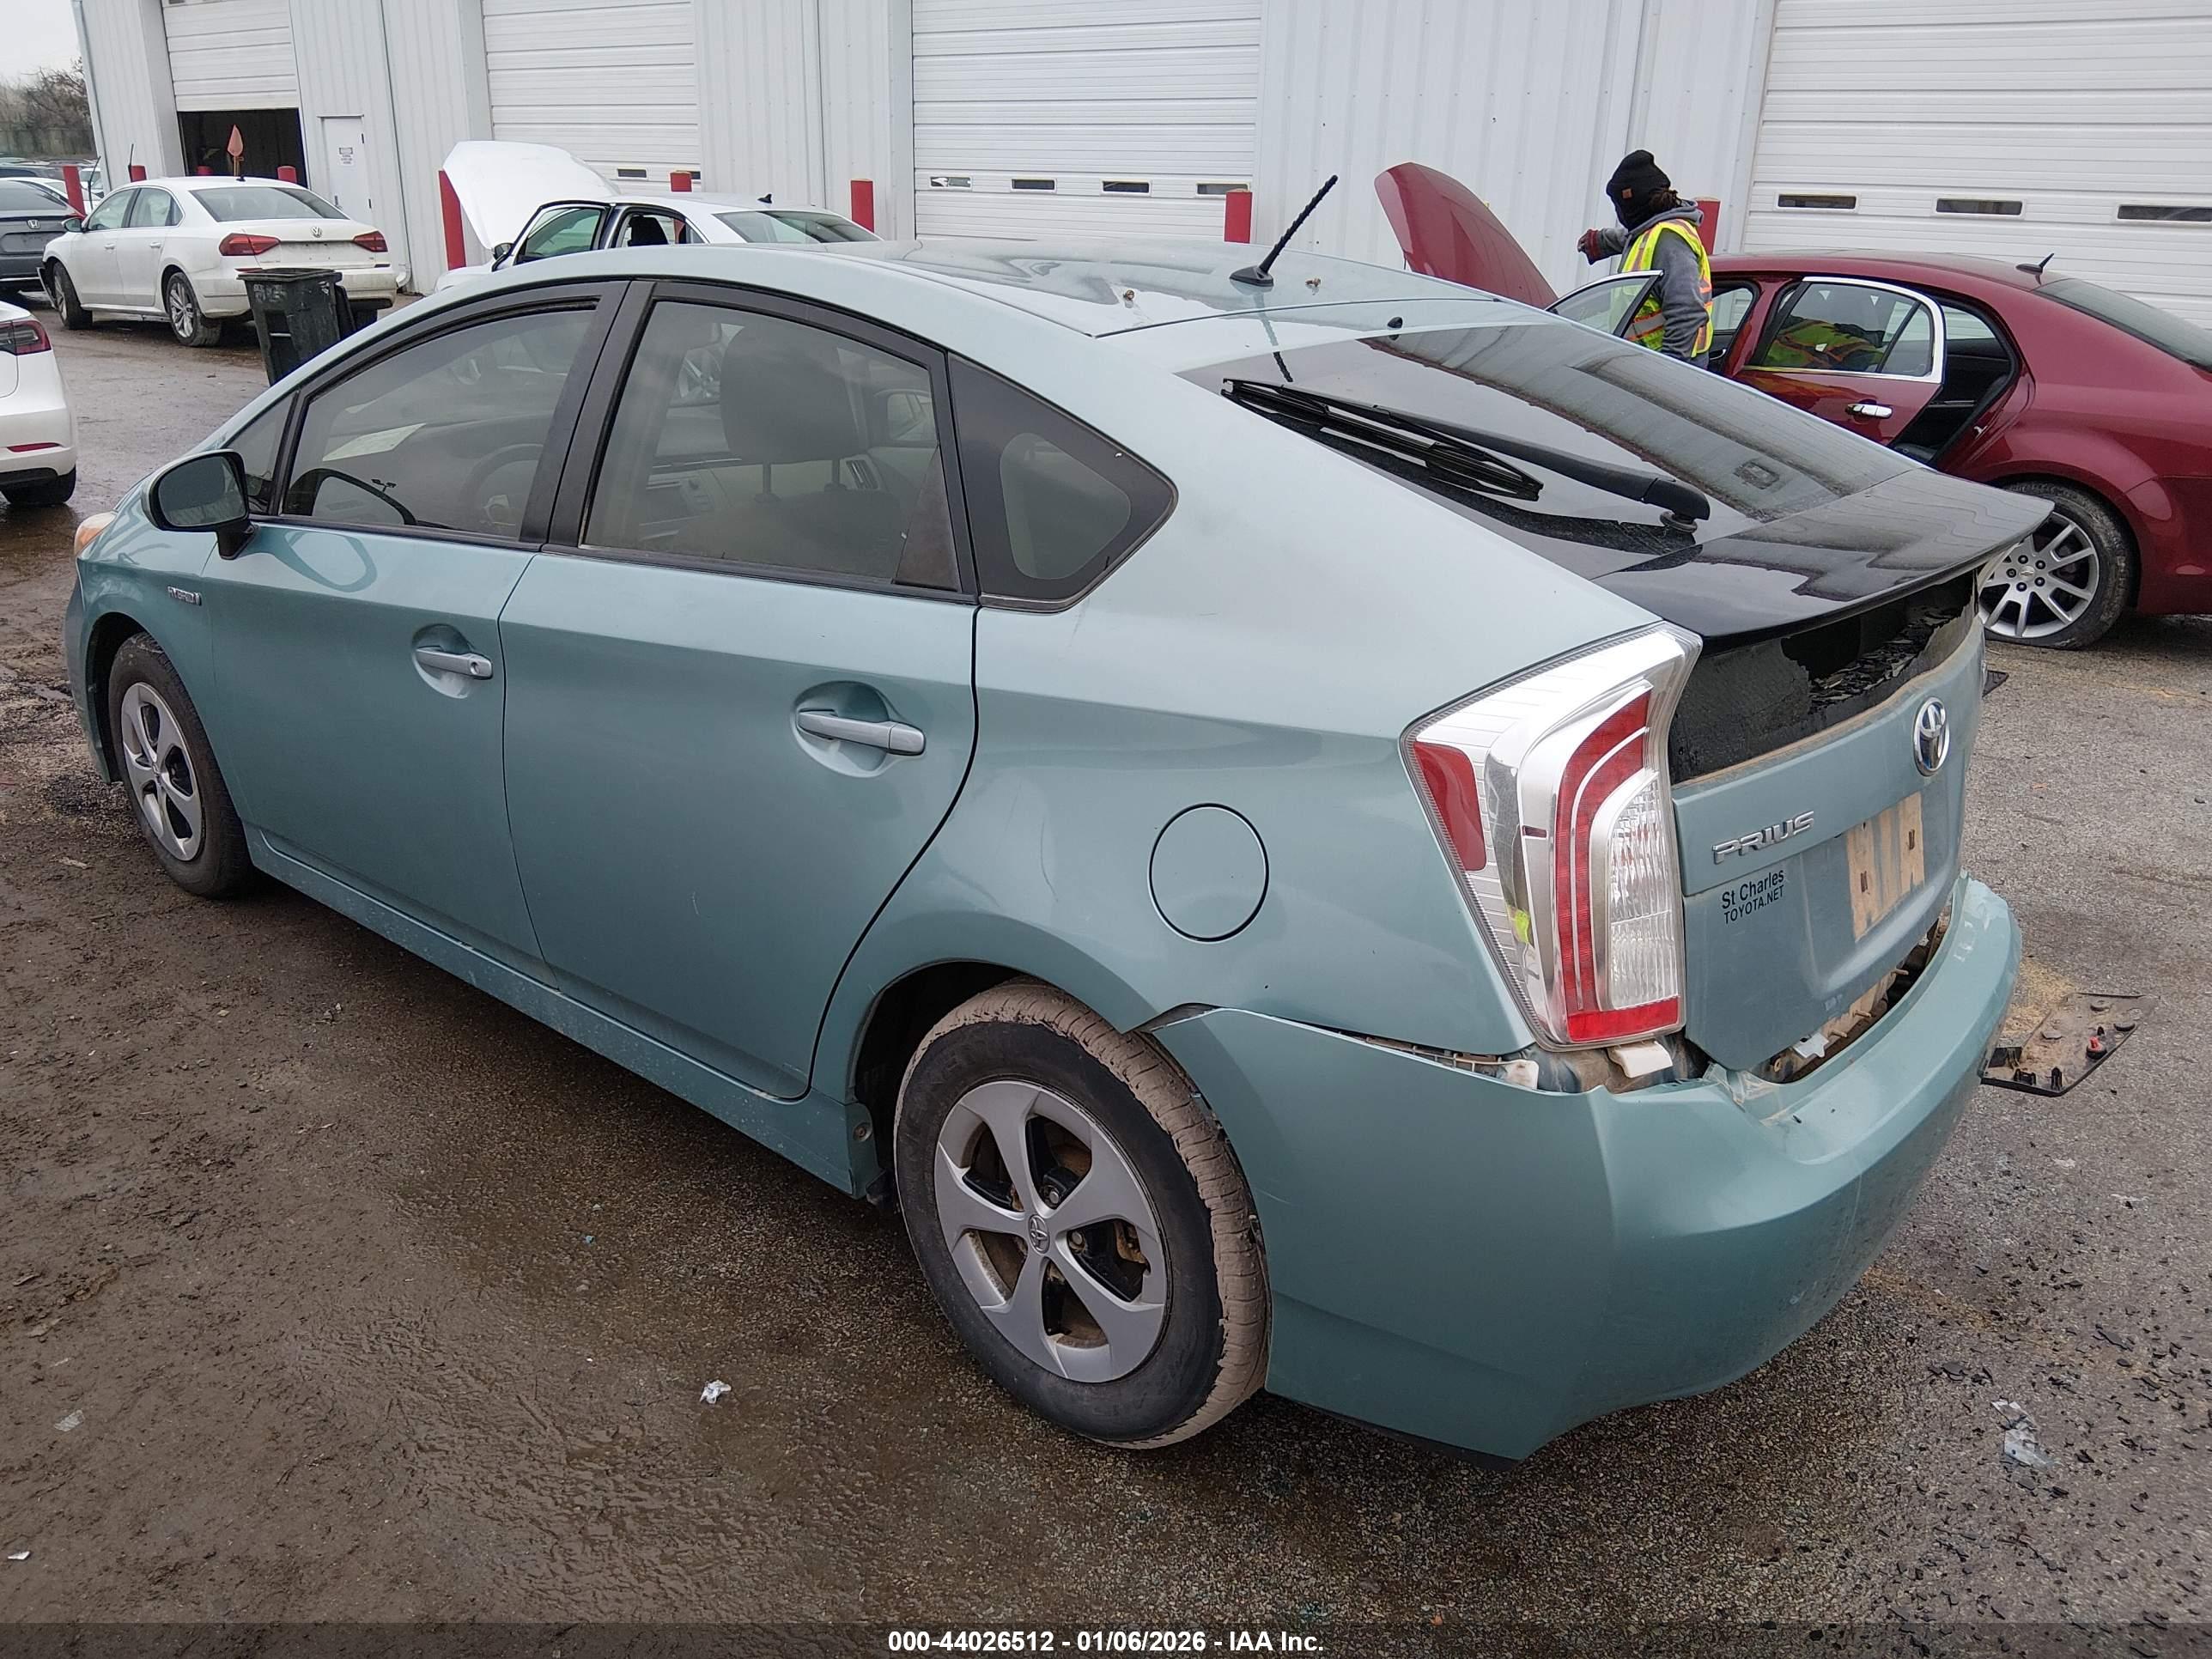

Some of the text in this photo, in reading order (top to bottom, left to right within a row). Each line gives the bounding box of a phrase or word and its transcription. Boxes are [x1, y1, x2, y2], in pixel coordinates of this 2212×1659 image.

[1712, 811, 1814, 864] PRIUS
[1723, 871, 1784, 909] St Charles
[1724, 886, 1784, 924] TOYOTA.NET
